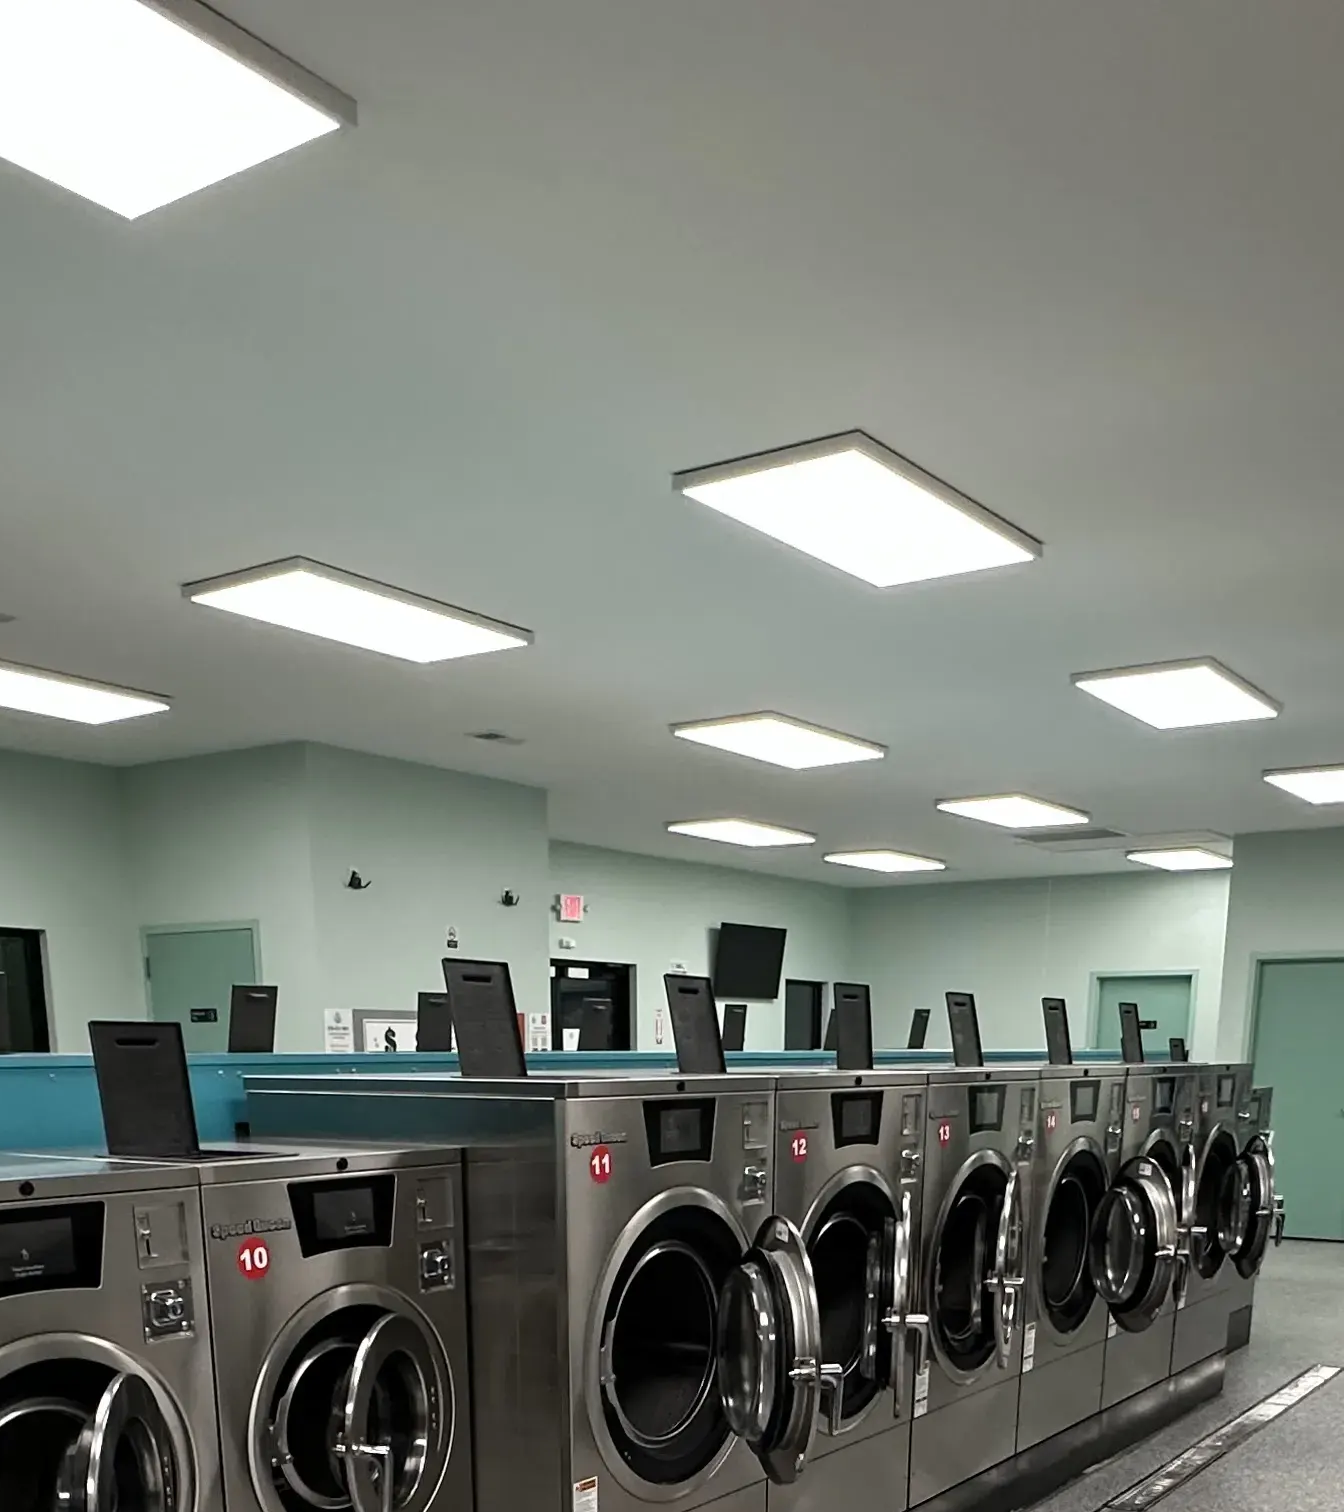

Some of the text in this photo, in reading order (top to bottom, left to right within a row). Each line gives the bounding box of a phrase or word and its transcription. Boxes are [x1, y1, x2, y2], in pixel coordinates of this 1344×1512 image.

[938, 1125, 950, 1141] 13
[791, 1138, 807, 1156] 12
[591, 1153, 610, 1175] 11
[210, 1220, 253, 1241] Speed
[239, 1246, 268, 1271] 10
